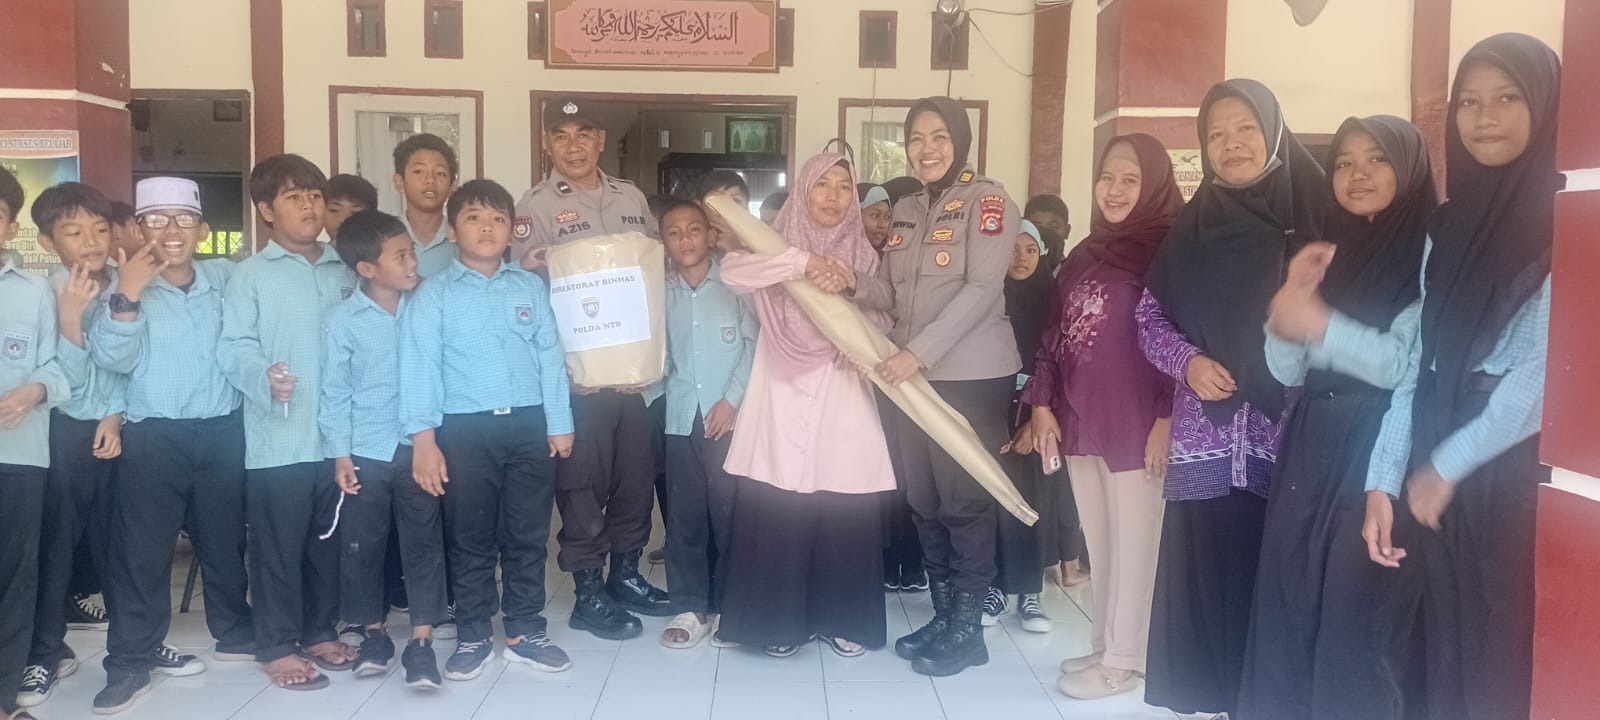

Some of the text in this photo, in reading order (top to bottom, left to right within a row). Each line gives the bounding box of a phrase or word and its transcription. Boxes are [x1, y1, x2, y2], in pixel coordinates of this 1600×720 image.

[39, 138, 72, 149] BELAJAR
[936, 211, 965, 223] POLRI
[558, 221, 591, 237] AZIS
[551, 275, 636, 294] DIREKTORAT BINMAS
[573, 320, 622, 335] POLDA NTB
